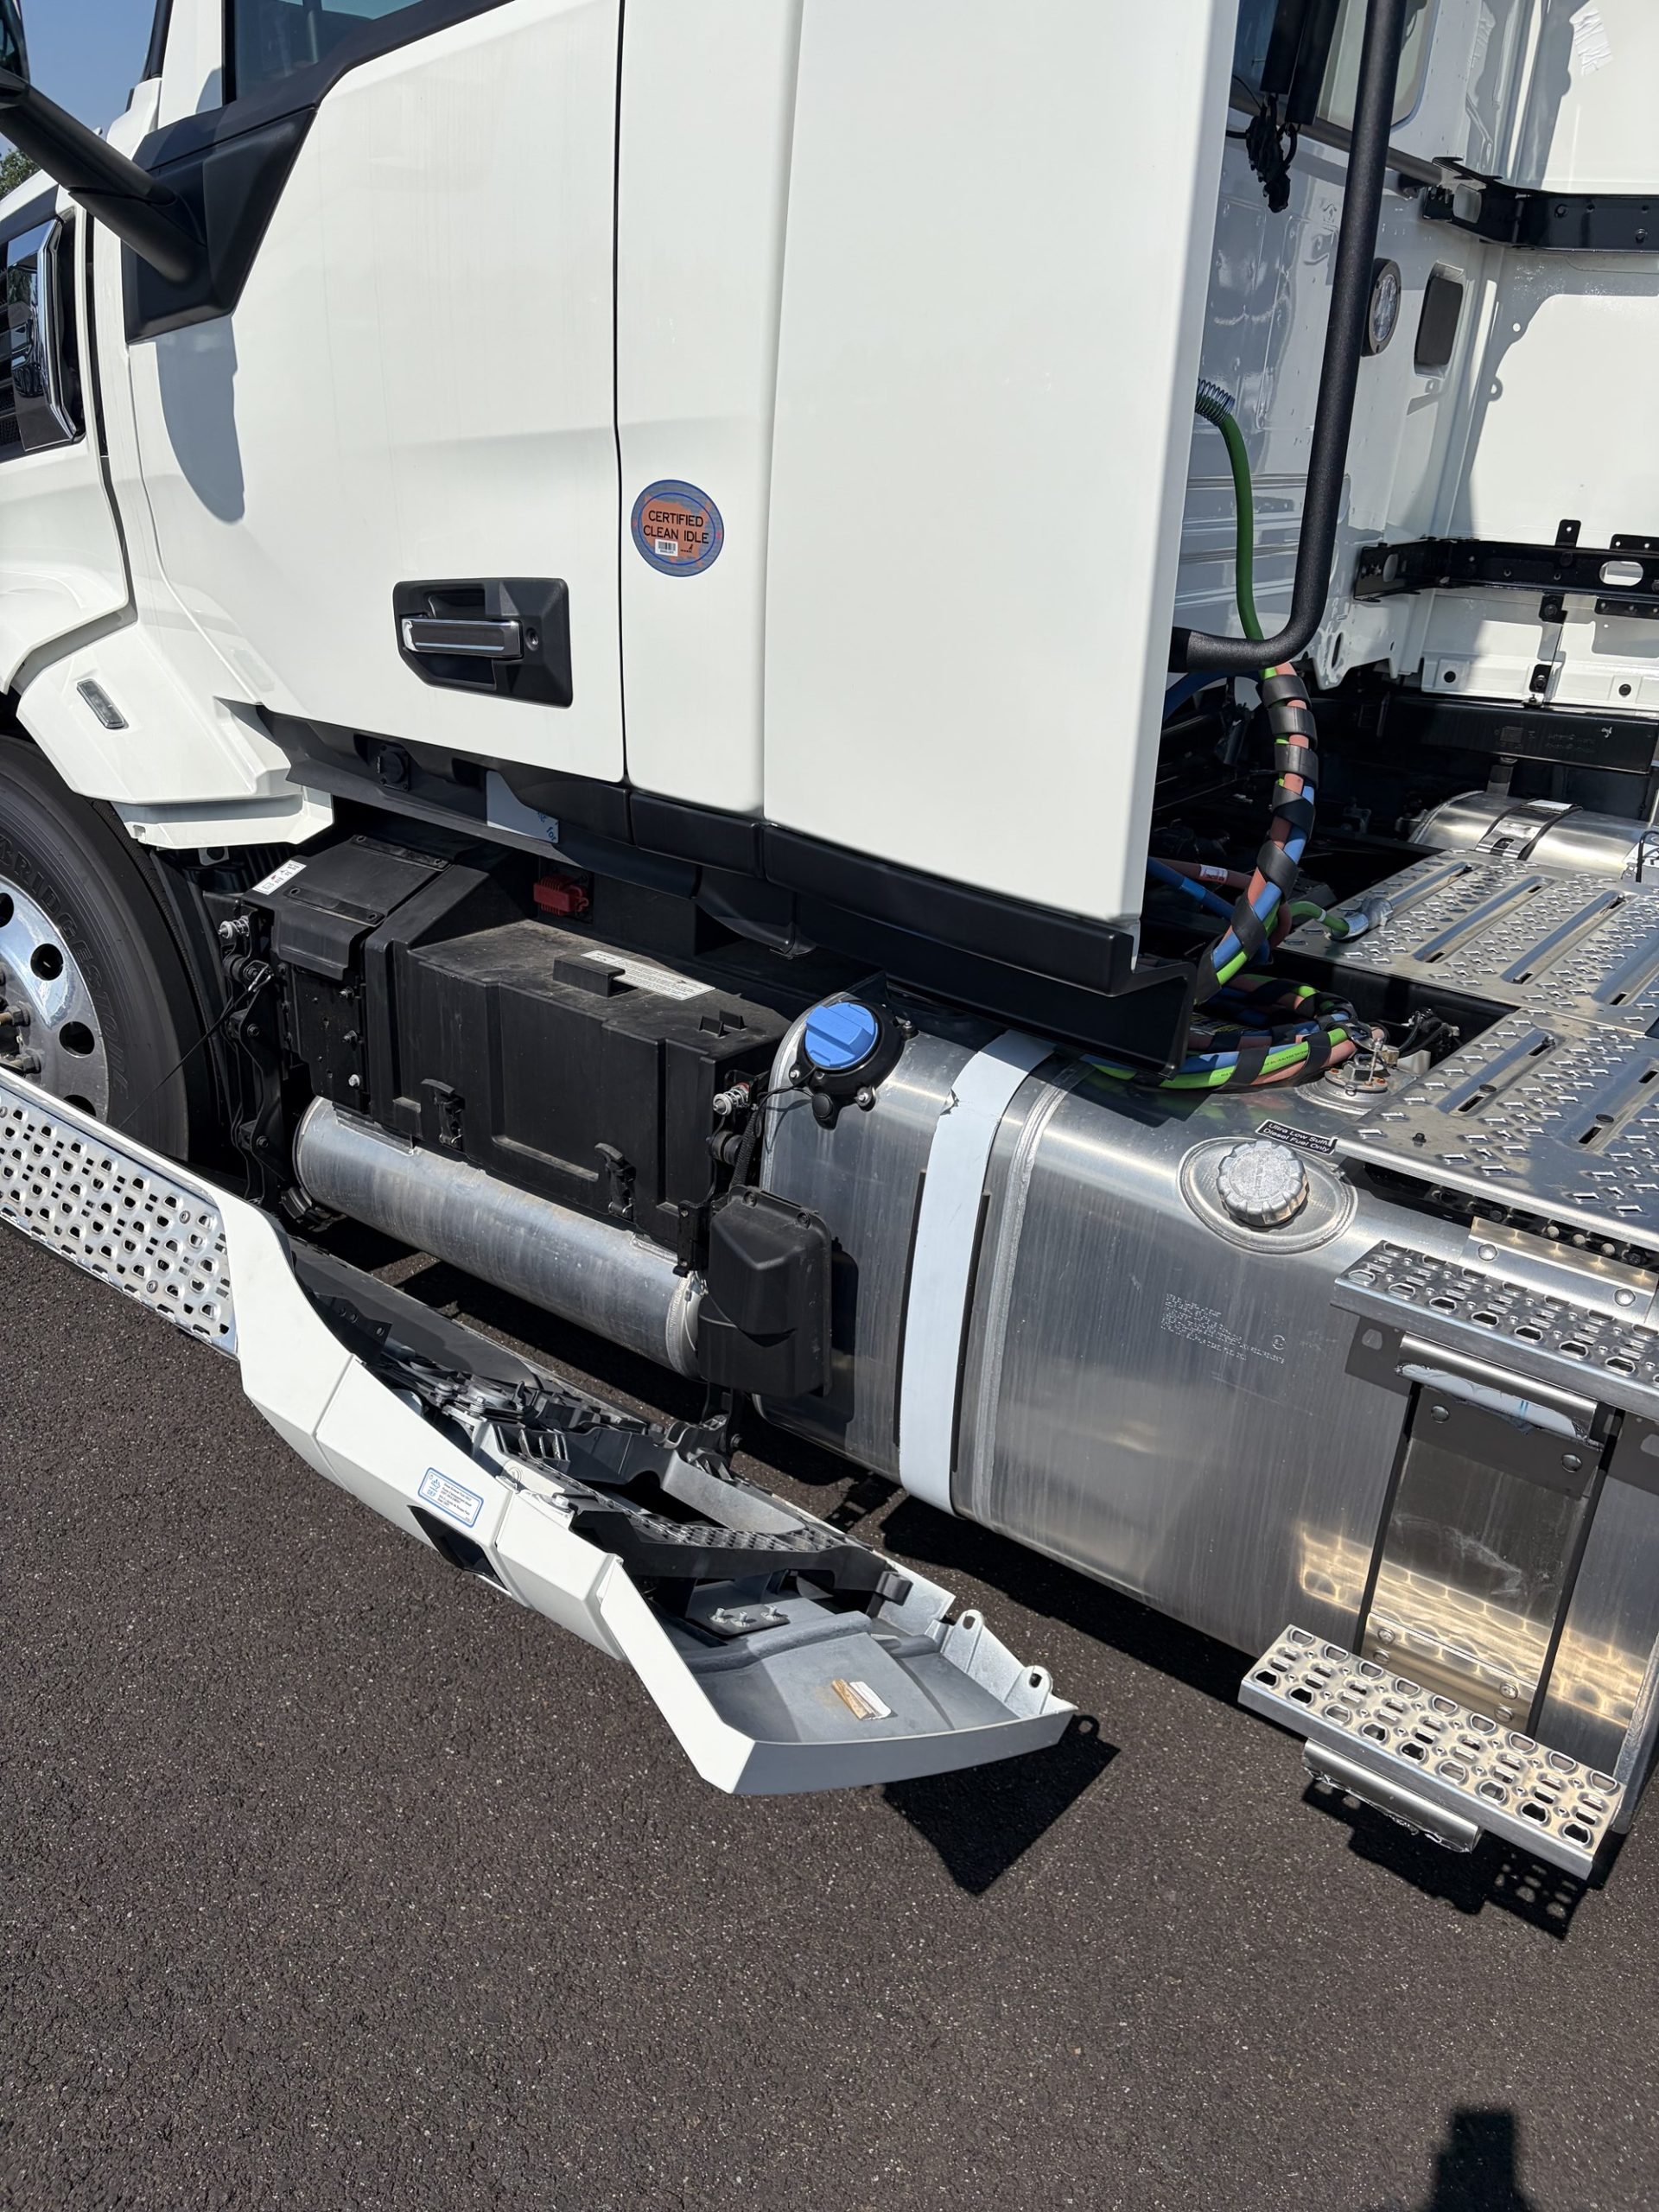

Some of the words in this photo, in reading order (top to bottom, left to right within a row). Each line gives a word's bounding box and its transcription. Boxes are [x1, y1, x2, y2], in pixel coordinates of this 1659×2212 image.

[648, 510, 704, 528] CERTIFIED
[643, 525, 679, 540] CLEAN
[683, 530, 709, 544] IDLE
[0, 834, 129, 1100] BRIDGESTONE
[1262, 1128, 1289, 1141] Diesel
[1290, 1137, 1309, 1147] Fuel
[1310, 1143, 1331, 1153] Only
[1268, 1122, 1287, 1134] Ultra
[1289, 1130, 1308, 1140] Low
